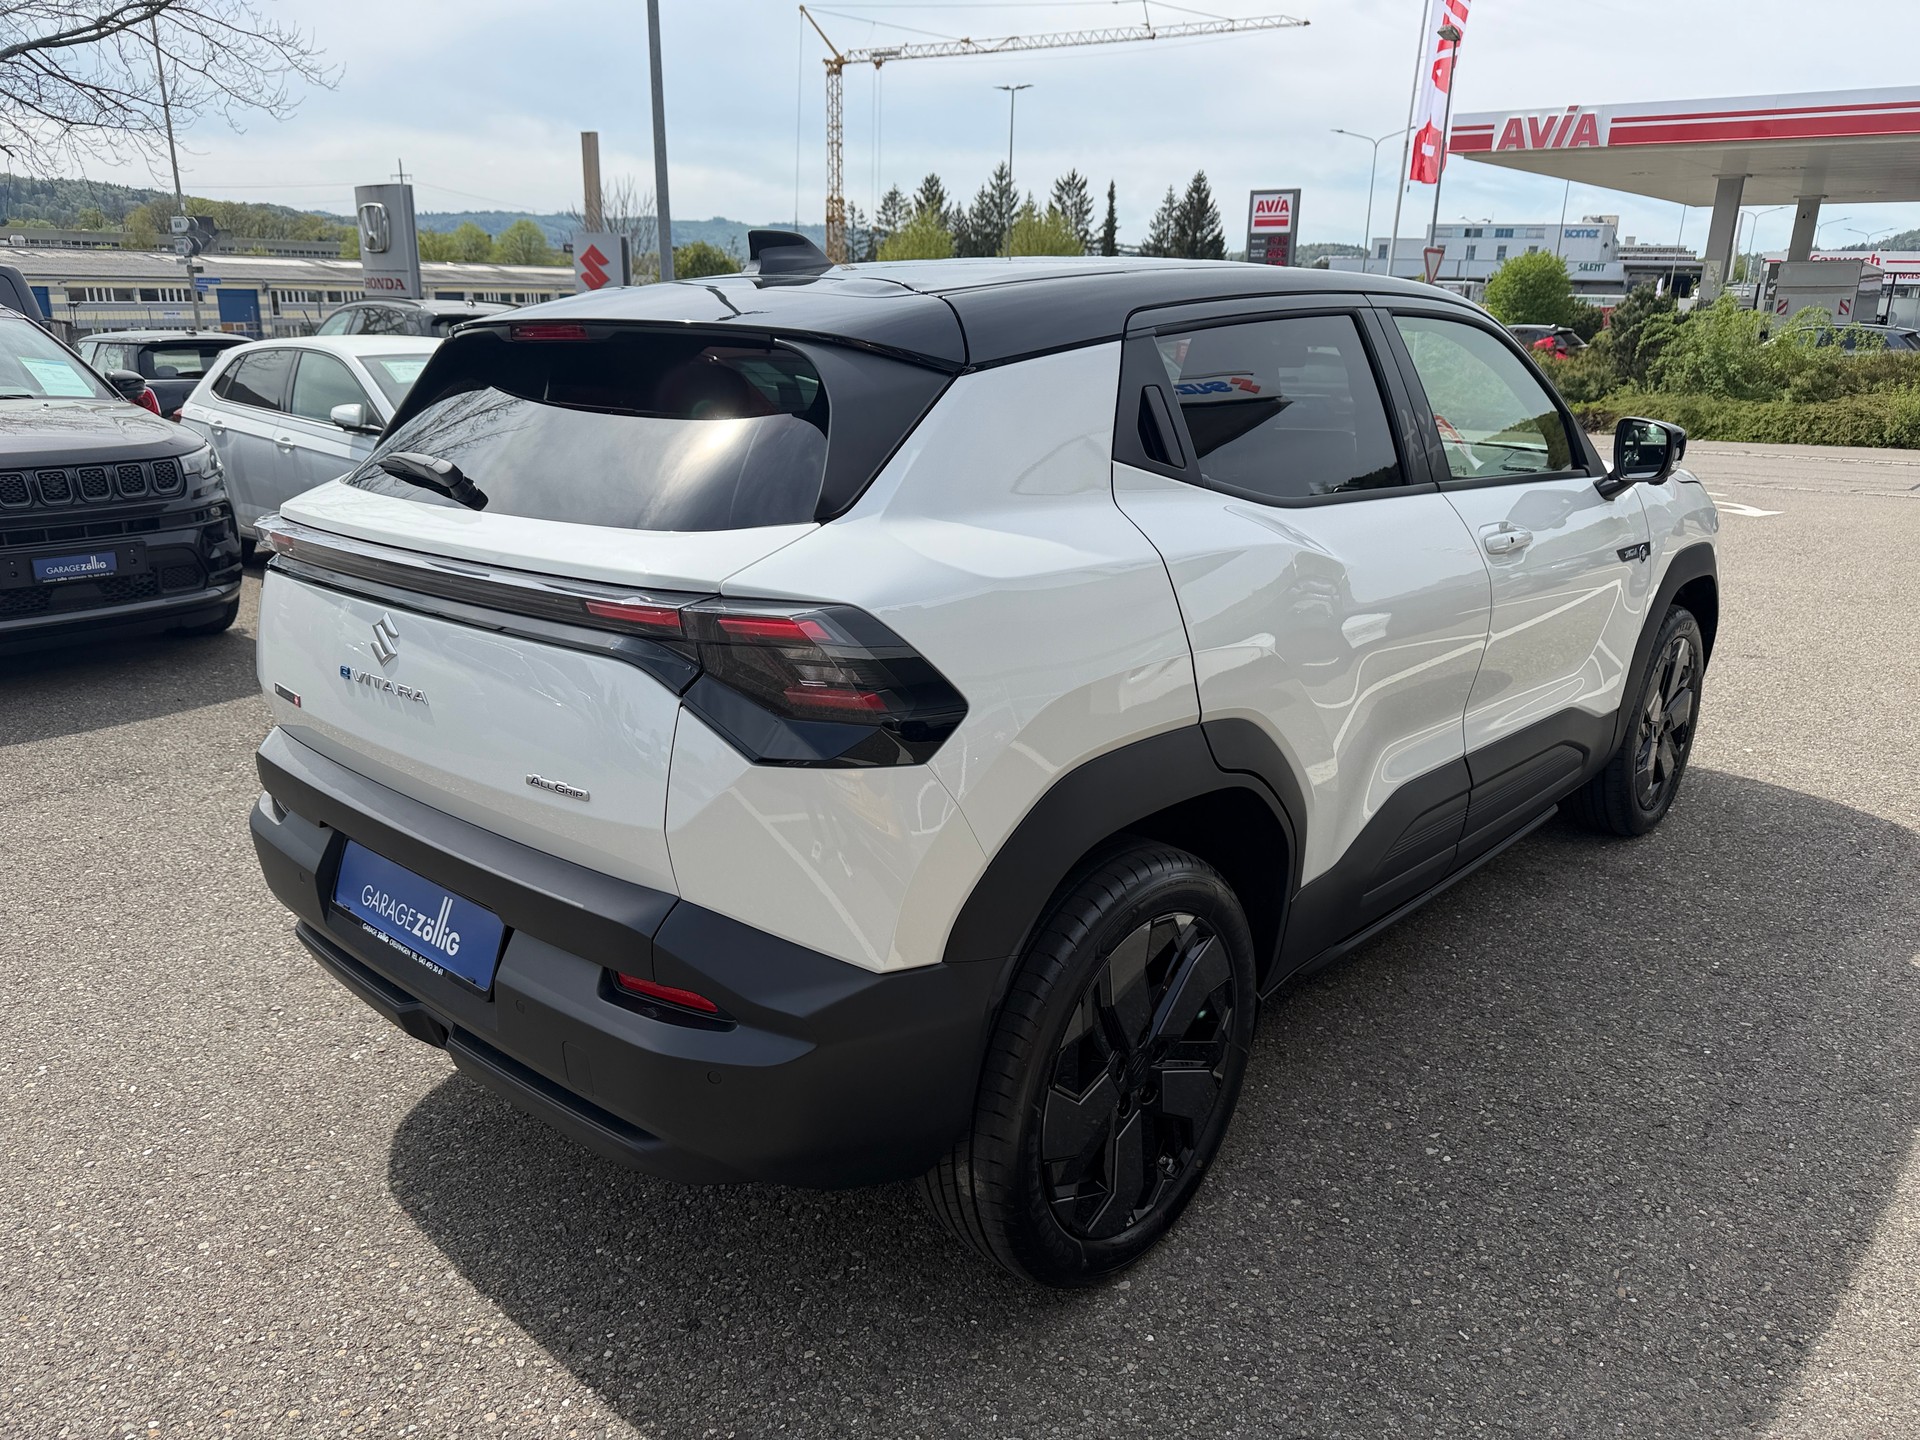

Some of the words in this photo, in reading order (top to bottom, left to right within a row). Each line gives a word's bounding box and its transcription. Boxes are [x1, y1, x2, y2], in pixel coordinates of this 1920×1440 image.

[1496, 105, 1600, 150] AVIA
[1256, 196, 1290, 213] AVIA
[1578, 263, 1607, 272] SILENT
[364, 277, 407, 291] HONDA
[46, 564, 80, 575] GARAGE
[352, 668, 429, 705] VITARA
[361, 884, 416, 930] GARAGE
